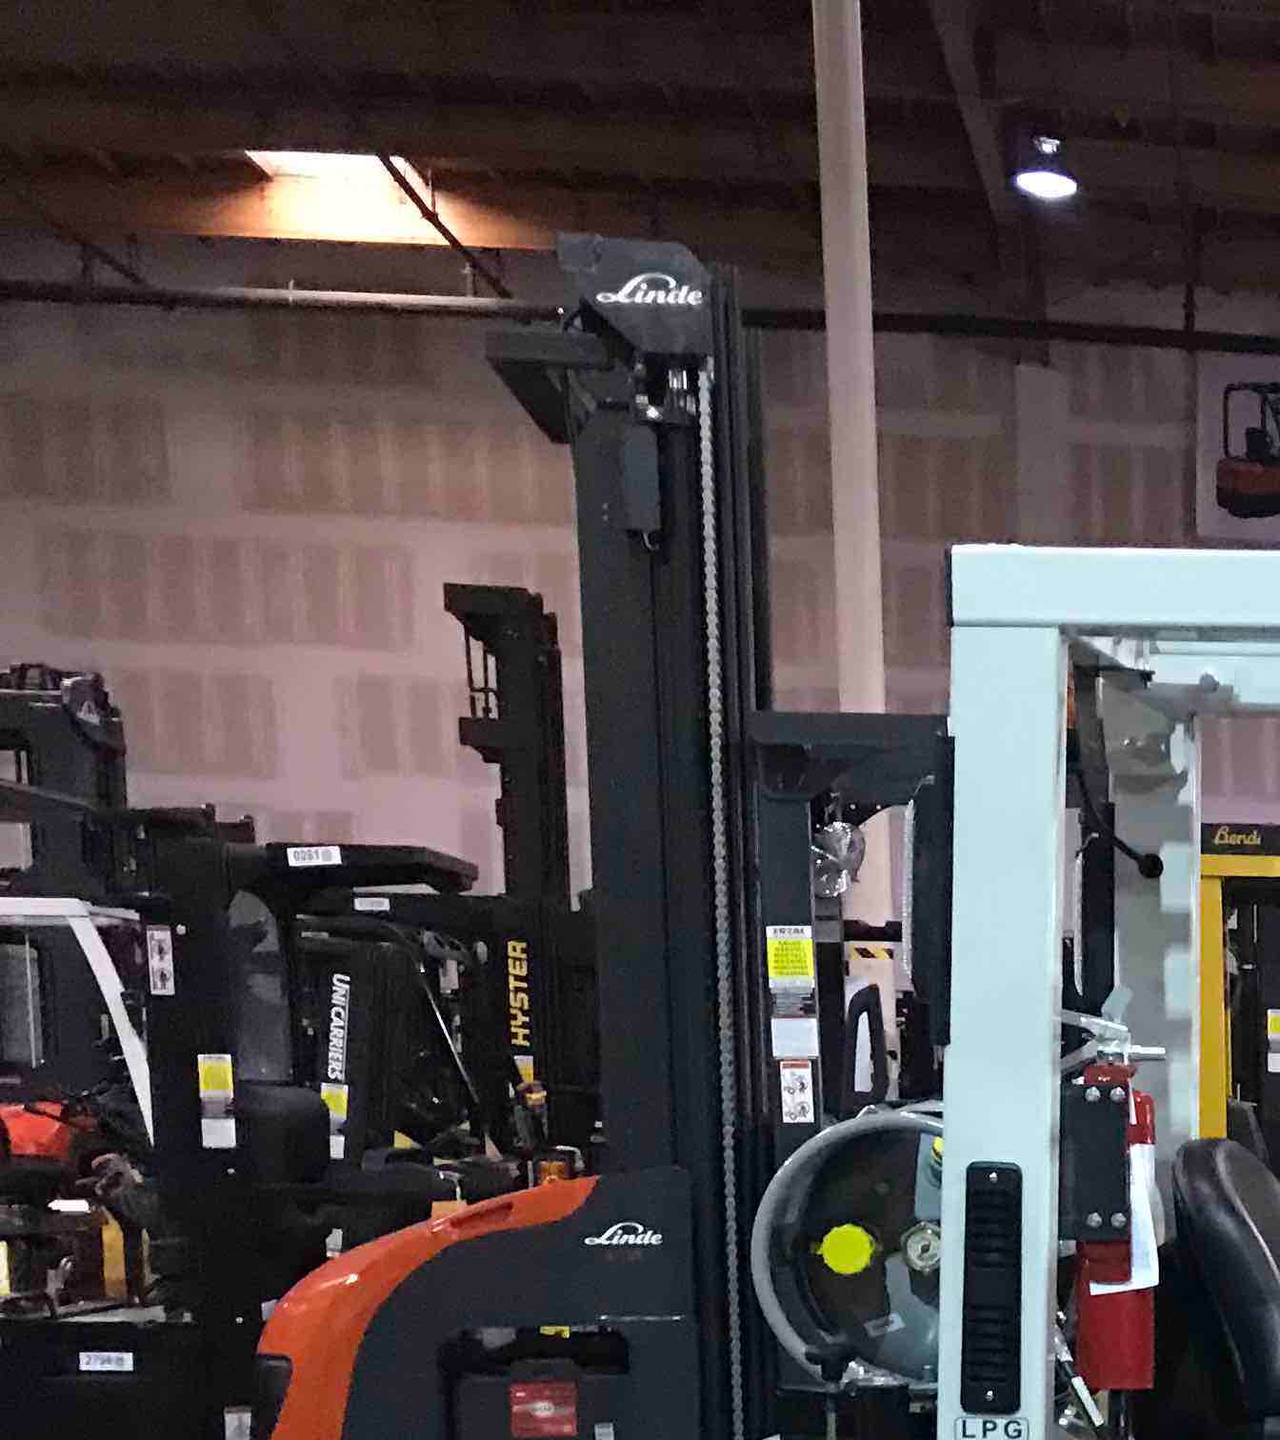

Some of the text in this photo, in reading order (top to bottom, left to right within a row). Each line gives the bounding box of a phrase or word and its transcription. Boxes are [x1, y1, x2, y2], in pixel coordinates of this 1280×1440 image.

[596, 272, 703, 305] Linde
[507, 940, 531, 1048] HYSTER
[584, 1221, 663, 1246] Linde
[960, 1419, 1024, 1440] LPG
